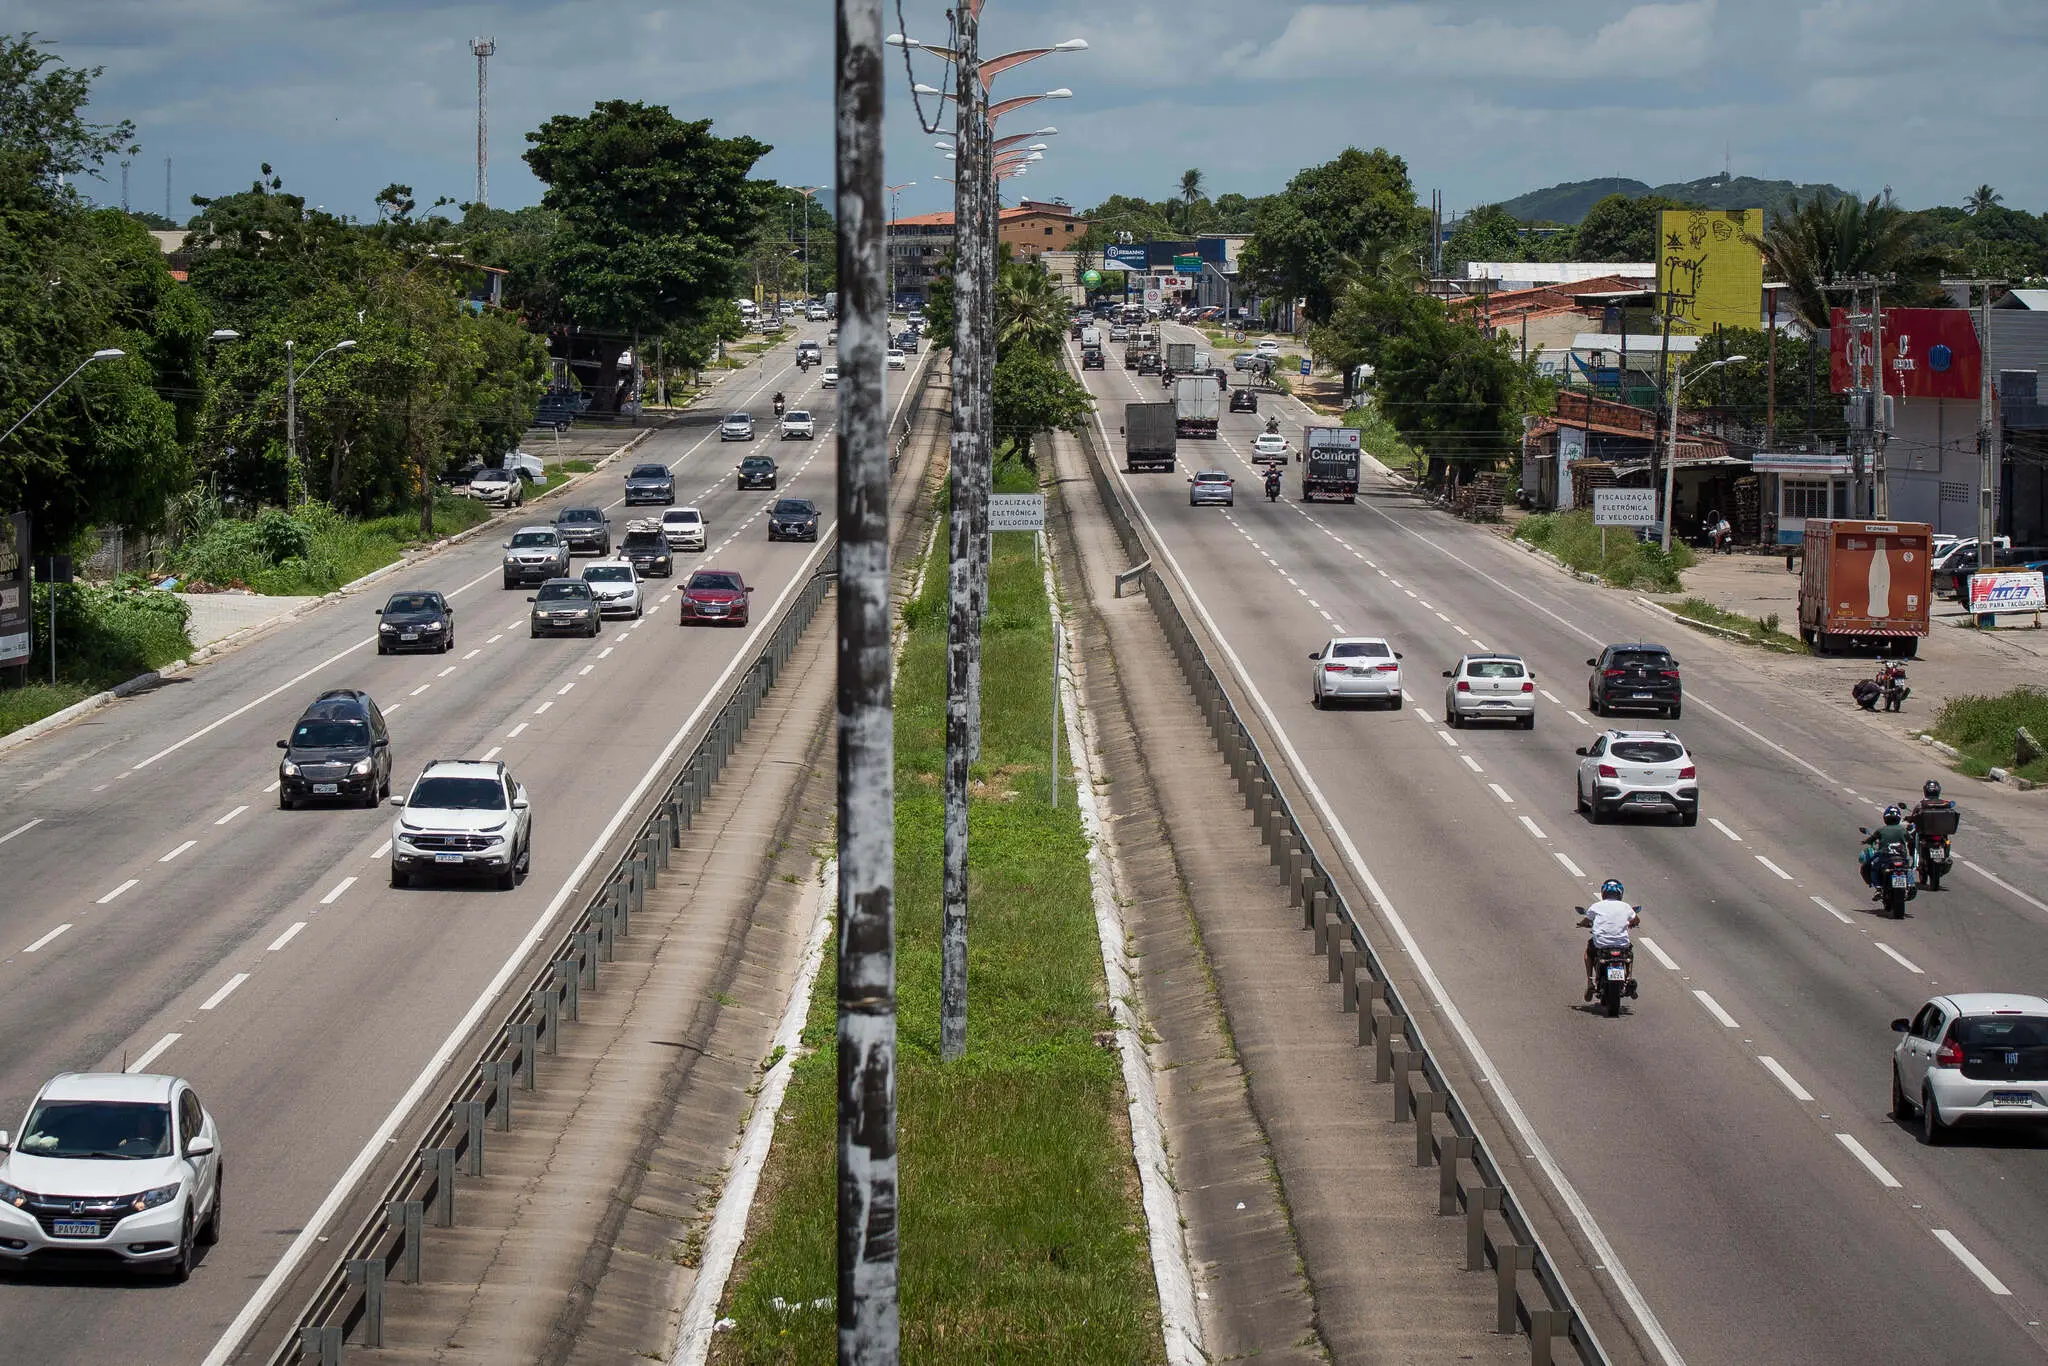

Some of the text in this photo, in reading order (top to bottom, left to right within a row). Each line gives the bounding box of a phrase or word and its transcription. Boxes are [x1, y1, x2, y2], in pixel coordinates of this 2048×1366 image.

[1311, 449, 1356, 461] Comfort
[1597, 493, 1653, 501] FISCALIZAÇÃO
[2005, 1053, 2018, 1064] FIAT
